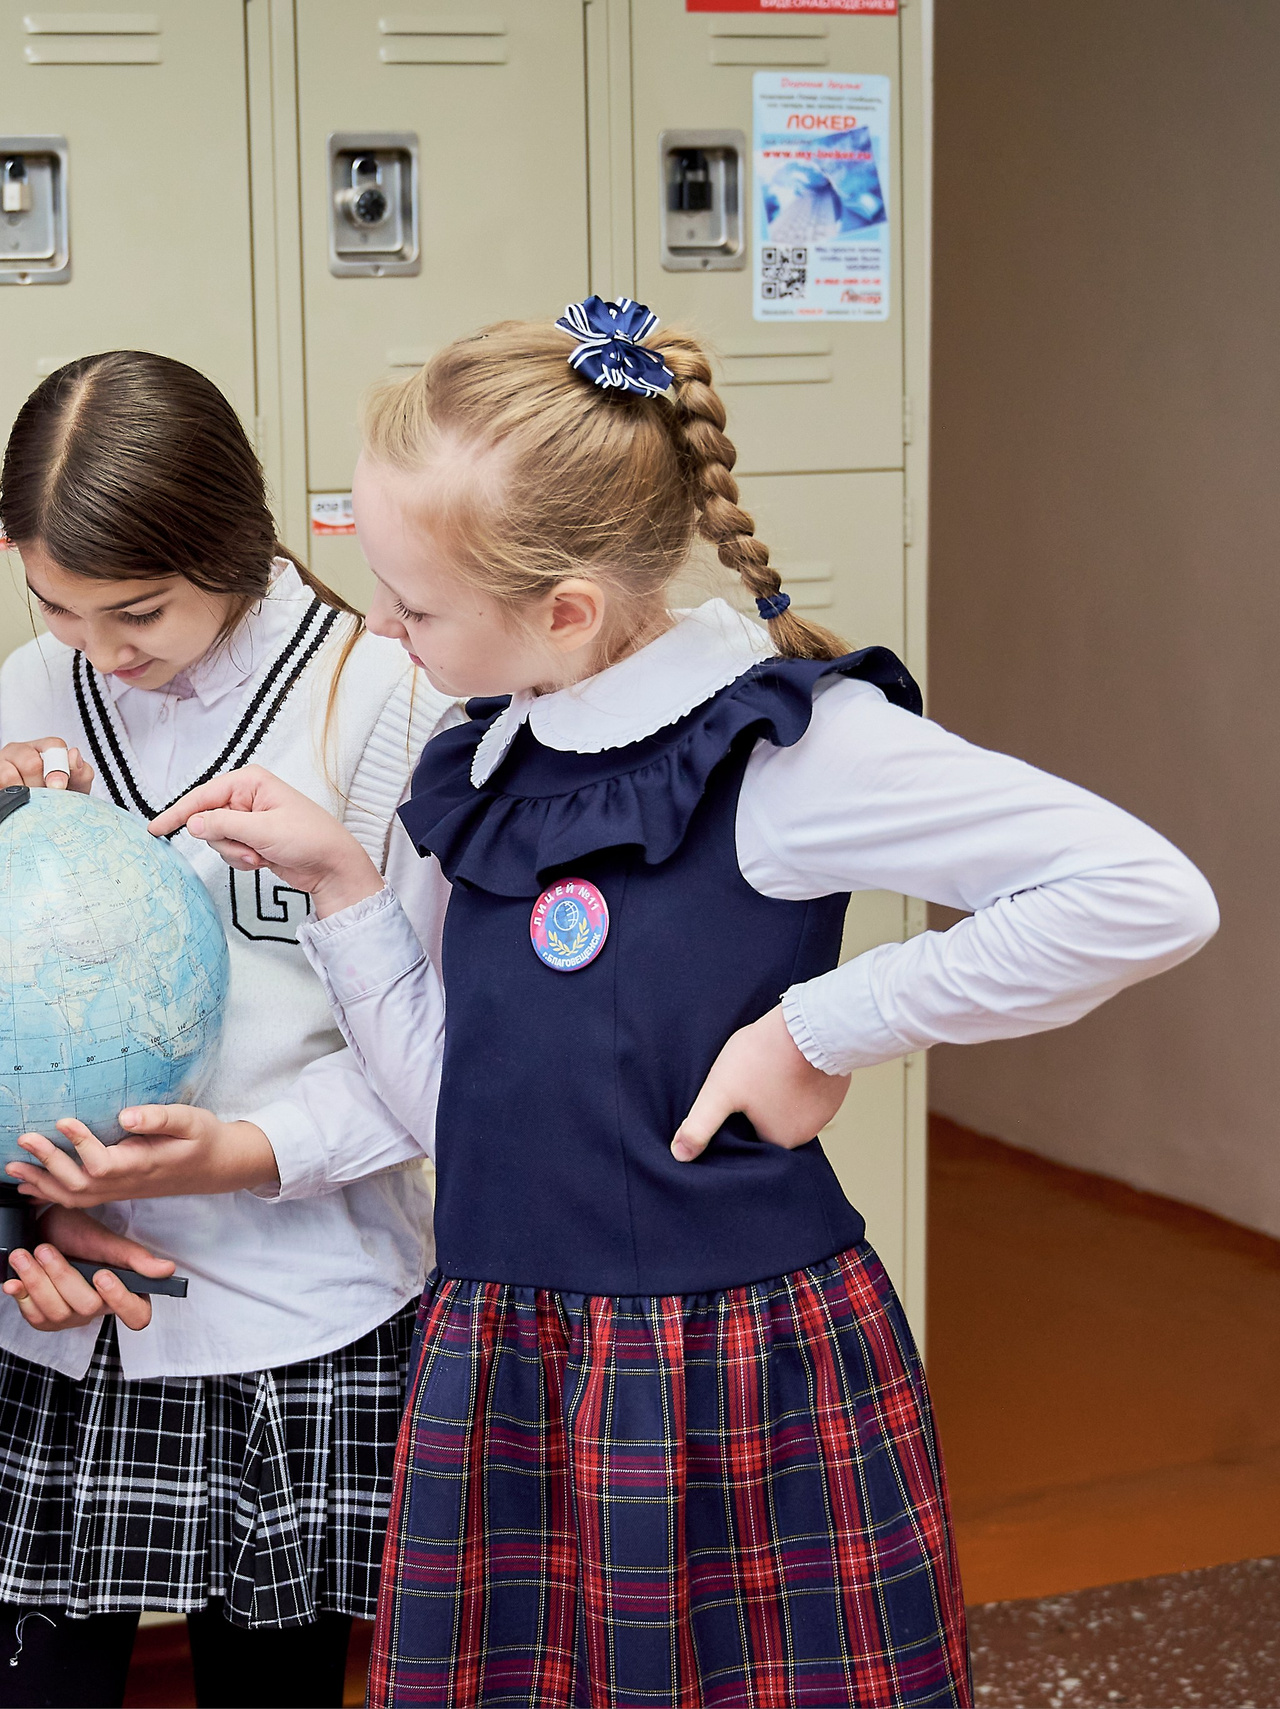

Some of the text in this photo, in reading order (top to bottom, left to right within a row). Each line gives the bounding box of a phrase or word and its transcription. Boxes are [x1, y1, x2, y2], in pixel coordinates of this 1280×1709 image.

[786, 114, 857, 129] ЛОКЕР
[533, 883, 600, 927] ЛИЦЕЙ №11
[542, 932, 601, 968] г.БЛАГОВЕЩЕНСК
